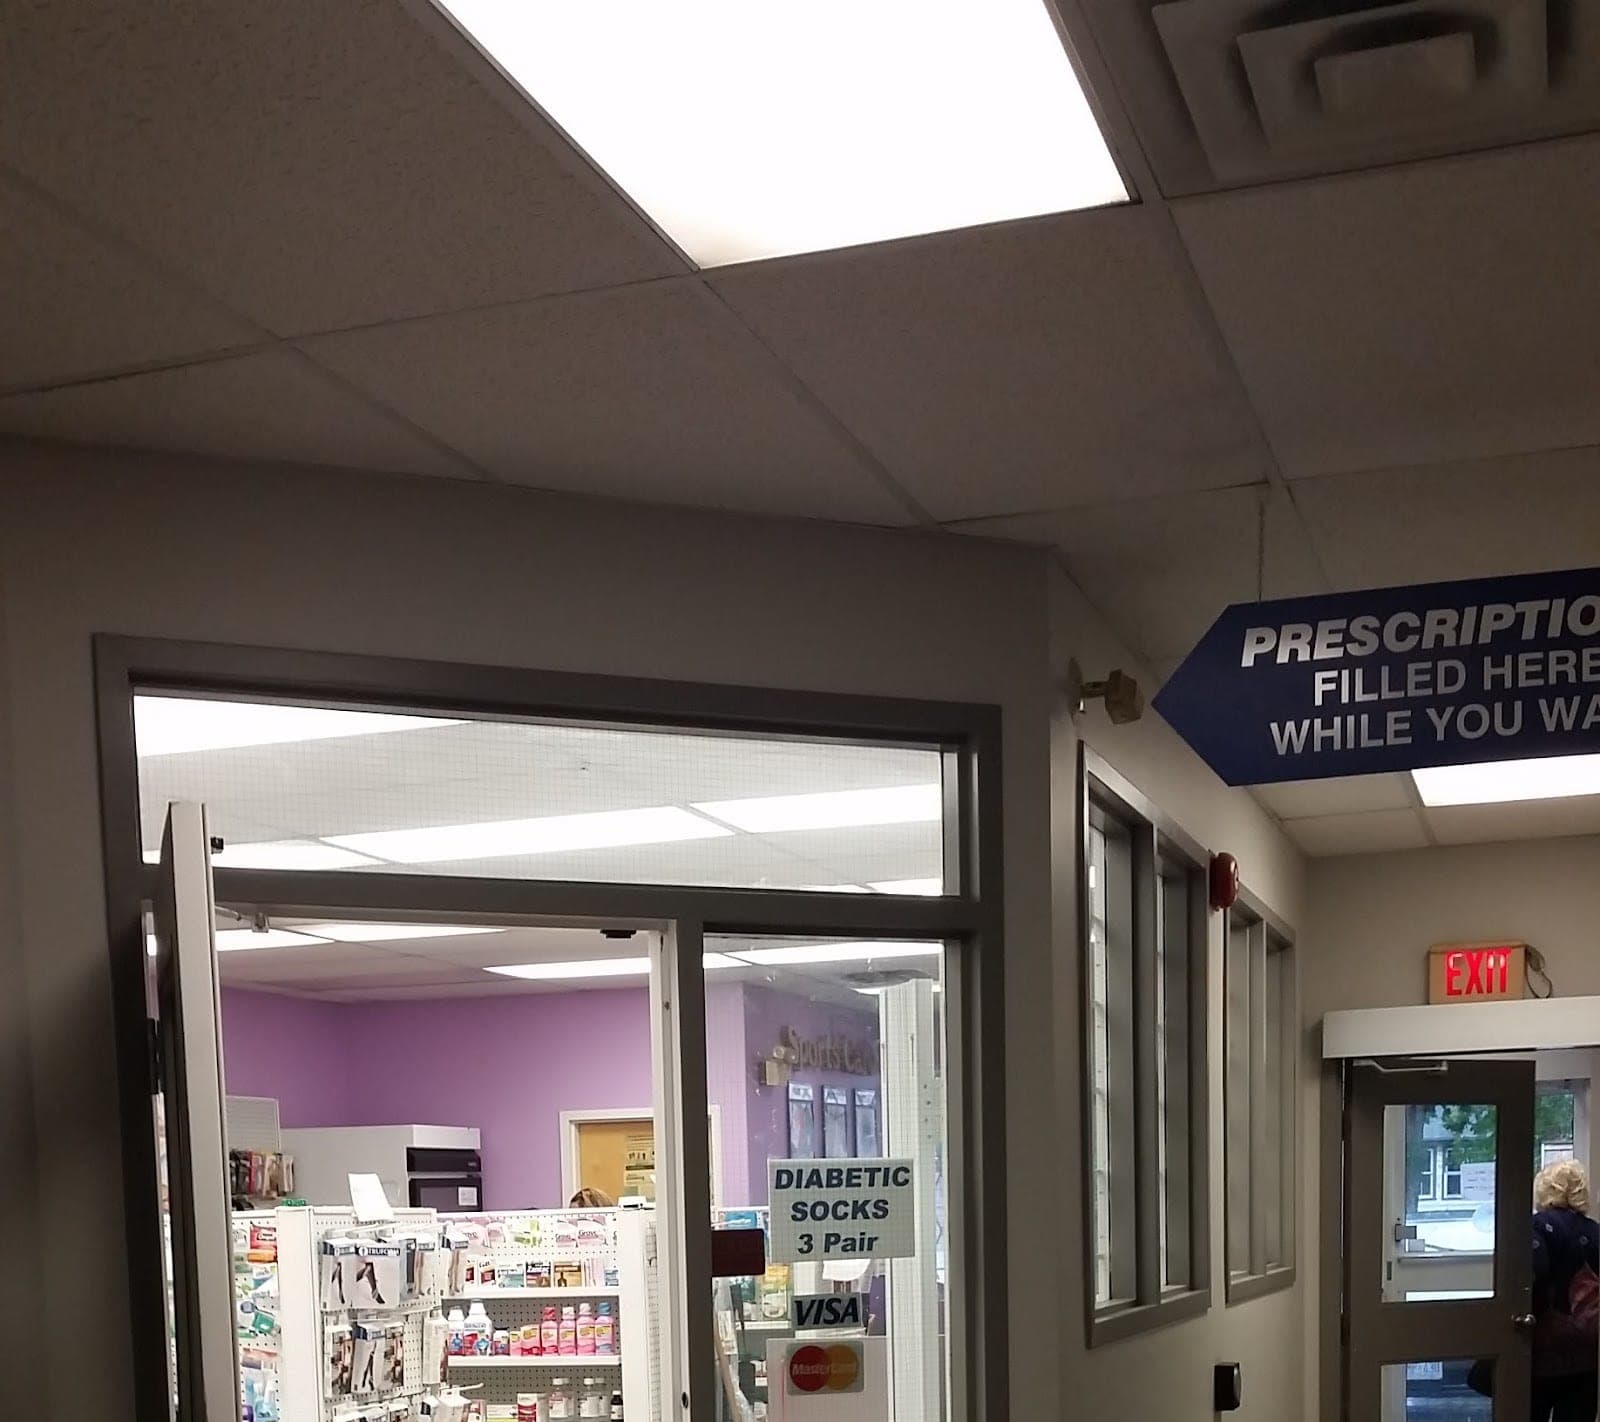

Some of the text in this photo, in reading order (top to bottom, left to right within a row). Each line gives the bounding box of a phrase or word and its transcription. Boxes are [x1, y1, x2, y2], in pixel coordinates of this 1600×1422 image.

[1241, 594, 1600, 668] PRESCRIPTIO
[1314, 648, 1600, 706] FILLED HERE
[1270, 710, 1413, 756] WHILE
[1426, 701, 1523, 741] YOU
[1445, 947, 1512, 996] EXIT
[774, 1166, 911, 1190] DIABETIC
[790, 1199, 889, 1222] SOCKS
[797, 1232, 879, 1254] 3 Pair
[795, 1297, 859, 1326] VISA
